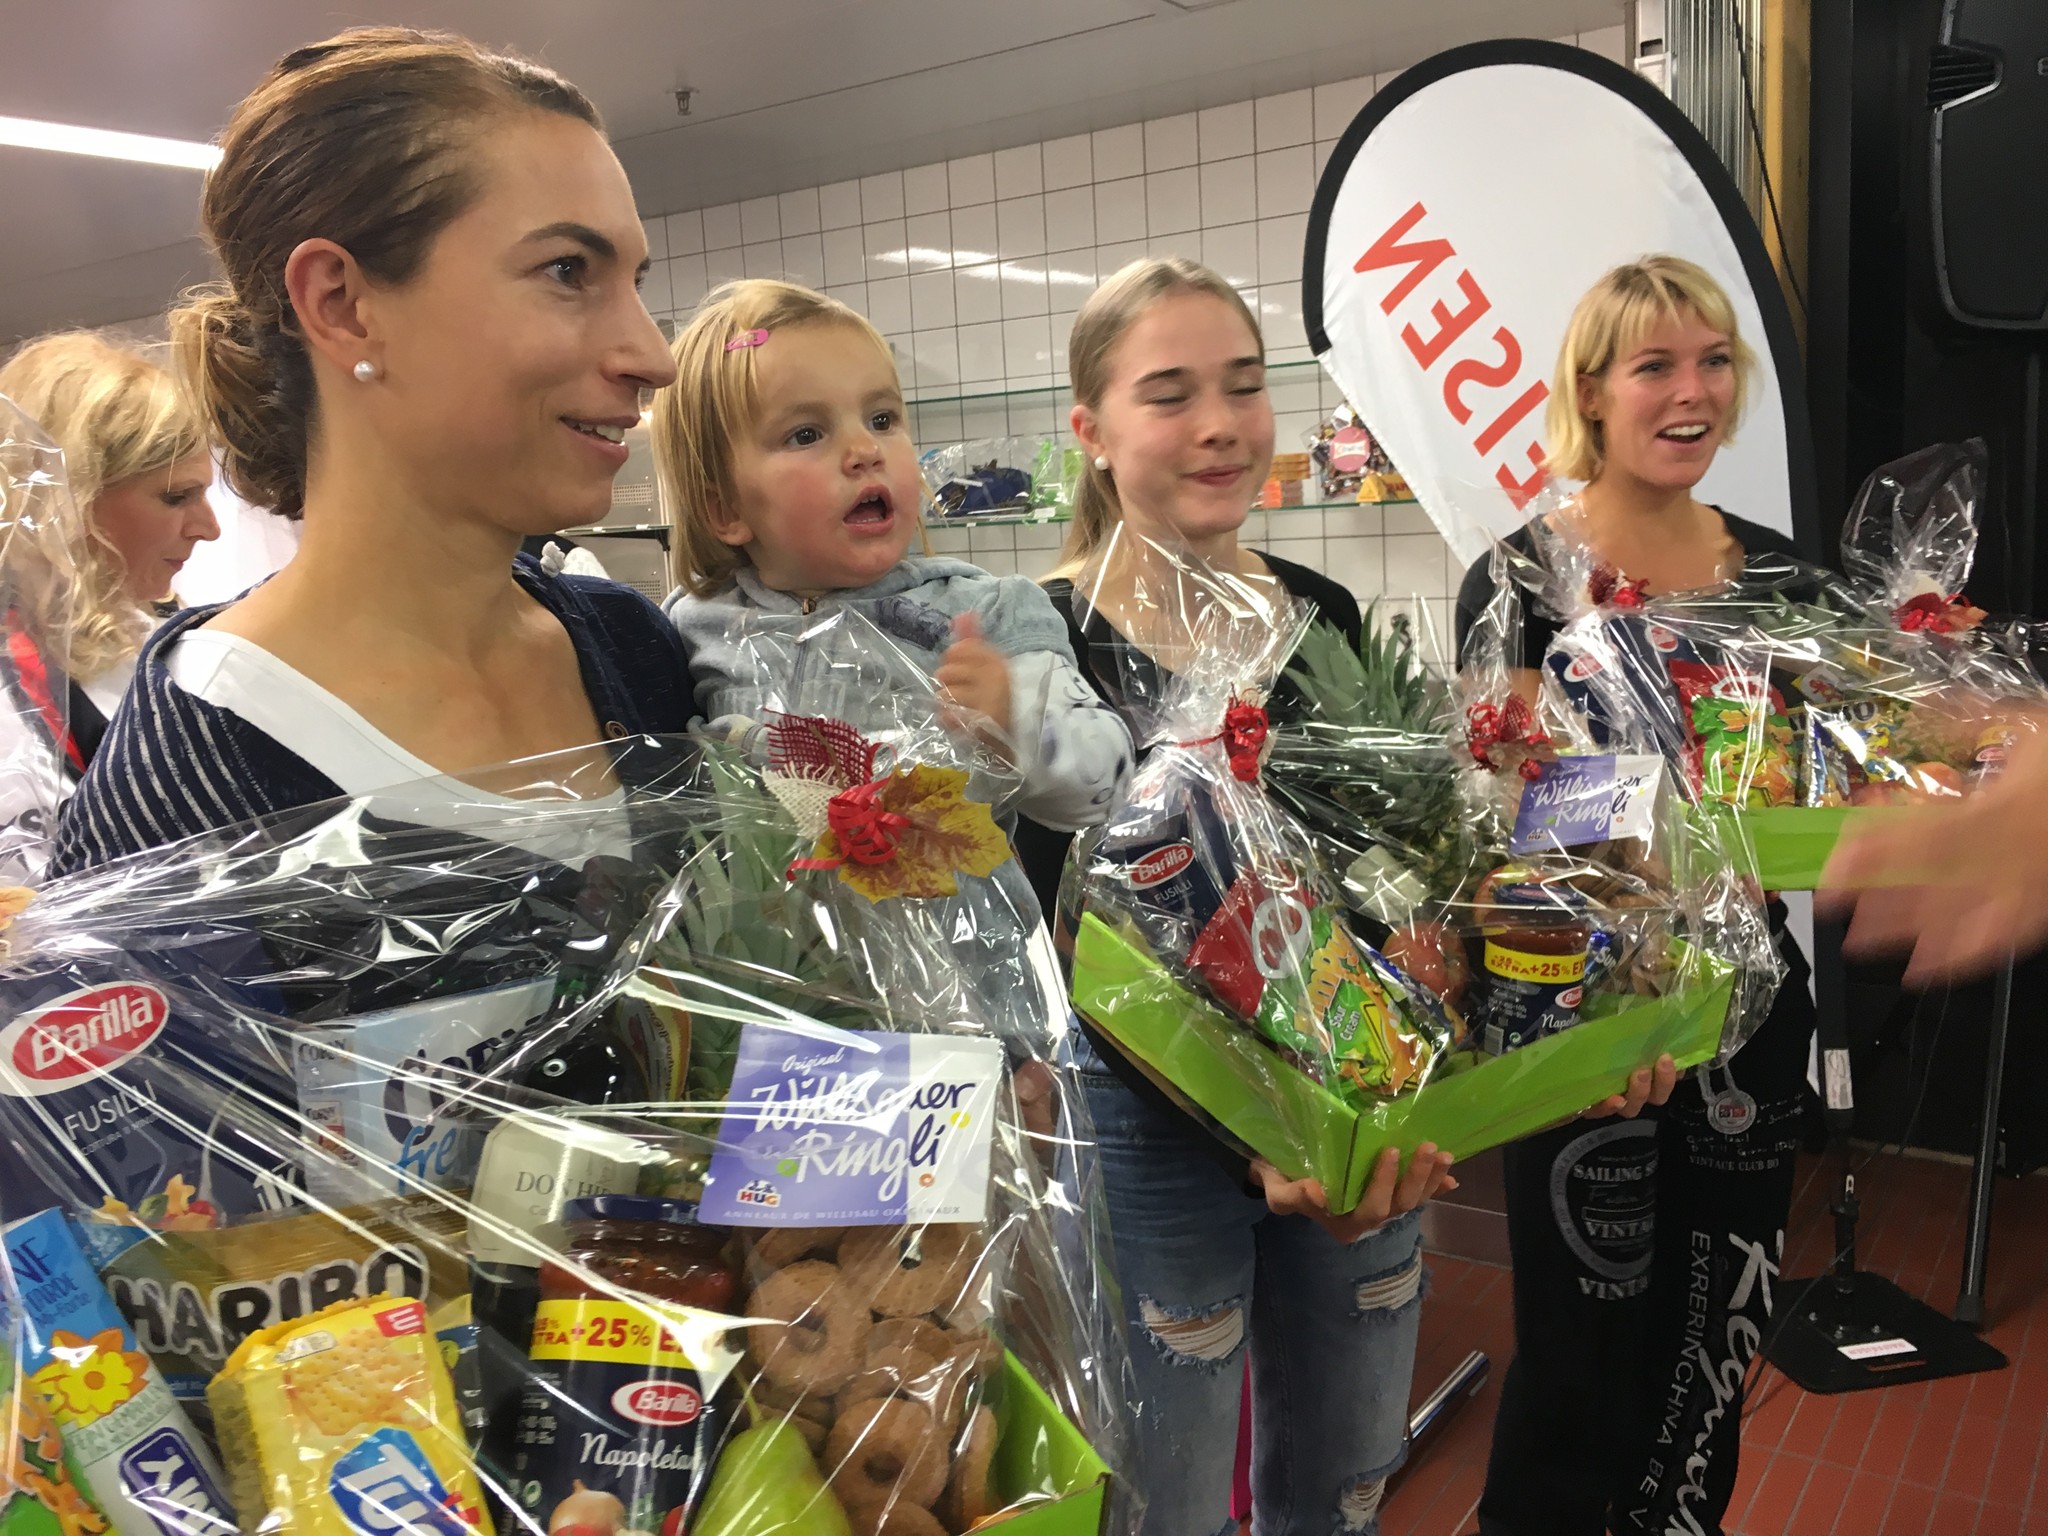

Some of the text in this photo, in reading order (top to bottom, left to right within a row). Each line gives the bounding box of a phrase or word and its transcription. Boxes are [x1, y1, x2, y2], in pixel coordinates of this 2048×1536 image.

[1555, 795, 1631, 832] Ringli
[1139, 845, 1188, 882] Barilla
[1154, 881, 1193, 905] FUSILLI
[1329, 1004, 1348, 1029] Sour
[1340, 1010, 1361, 1042] Cream
[31, 994, 153, 1072] Barilla
[782, 1047, 845, 1074] Original
[793, 1113, 946, 1202] Ringli
[1738, 1159, 1764, 1171] CLUB
[1573, 1164, 1643, 1182] SAILING
[739, 1190, 778, 1206] HUG
[103, 1243, 429, 1362] HARIBO
[389, 1306, 421, 1331] LU
[635, 1390, 697, 1414] Barilla
[1639, 1457, 1664, 1496] BE
